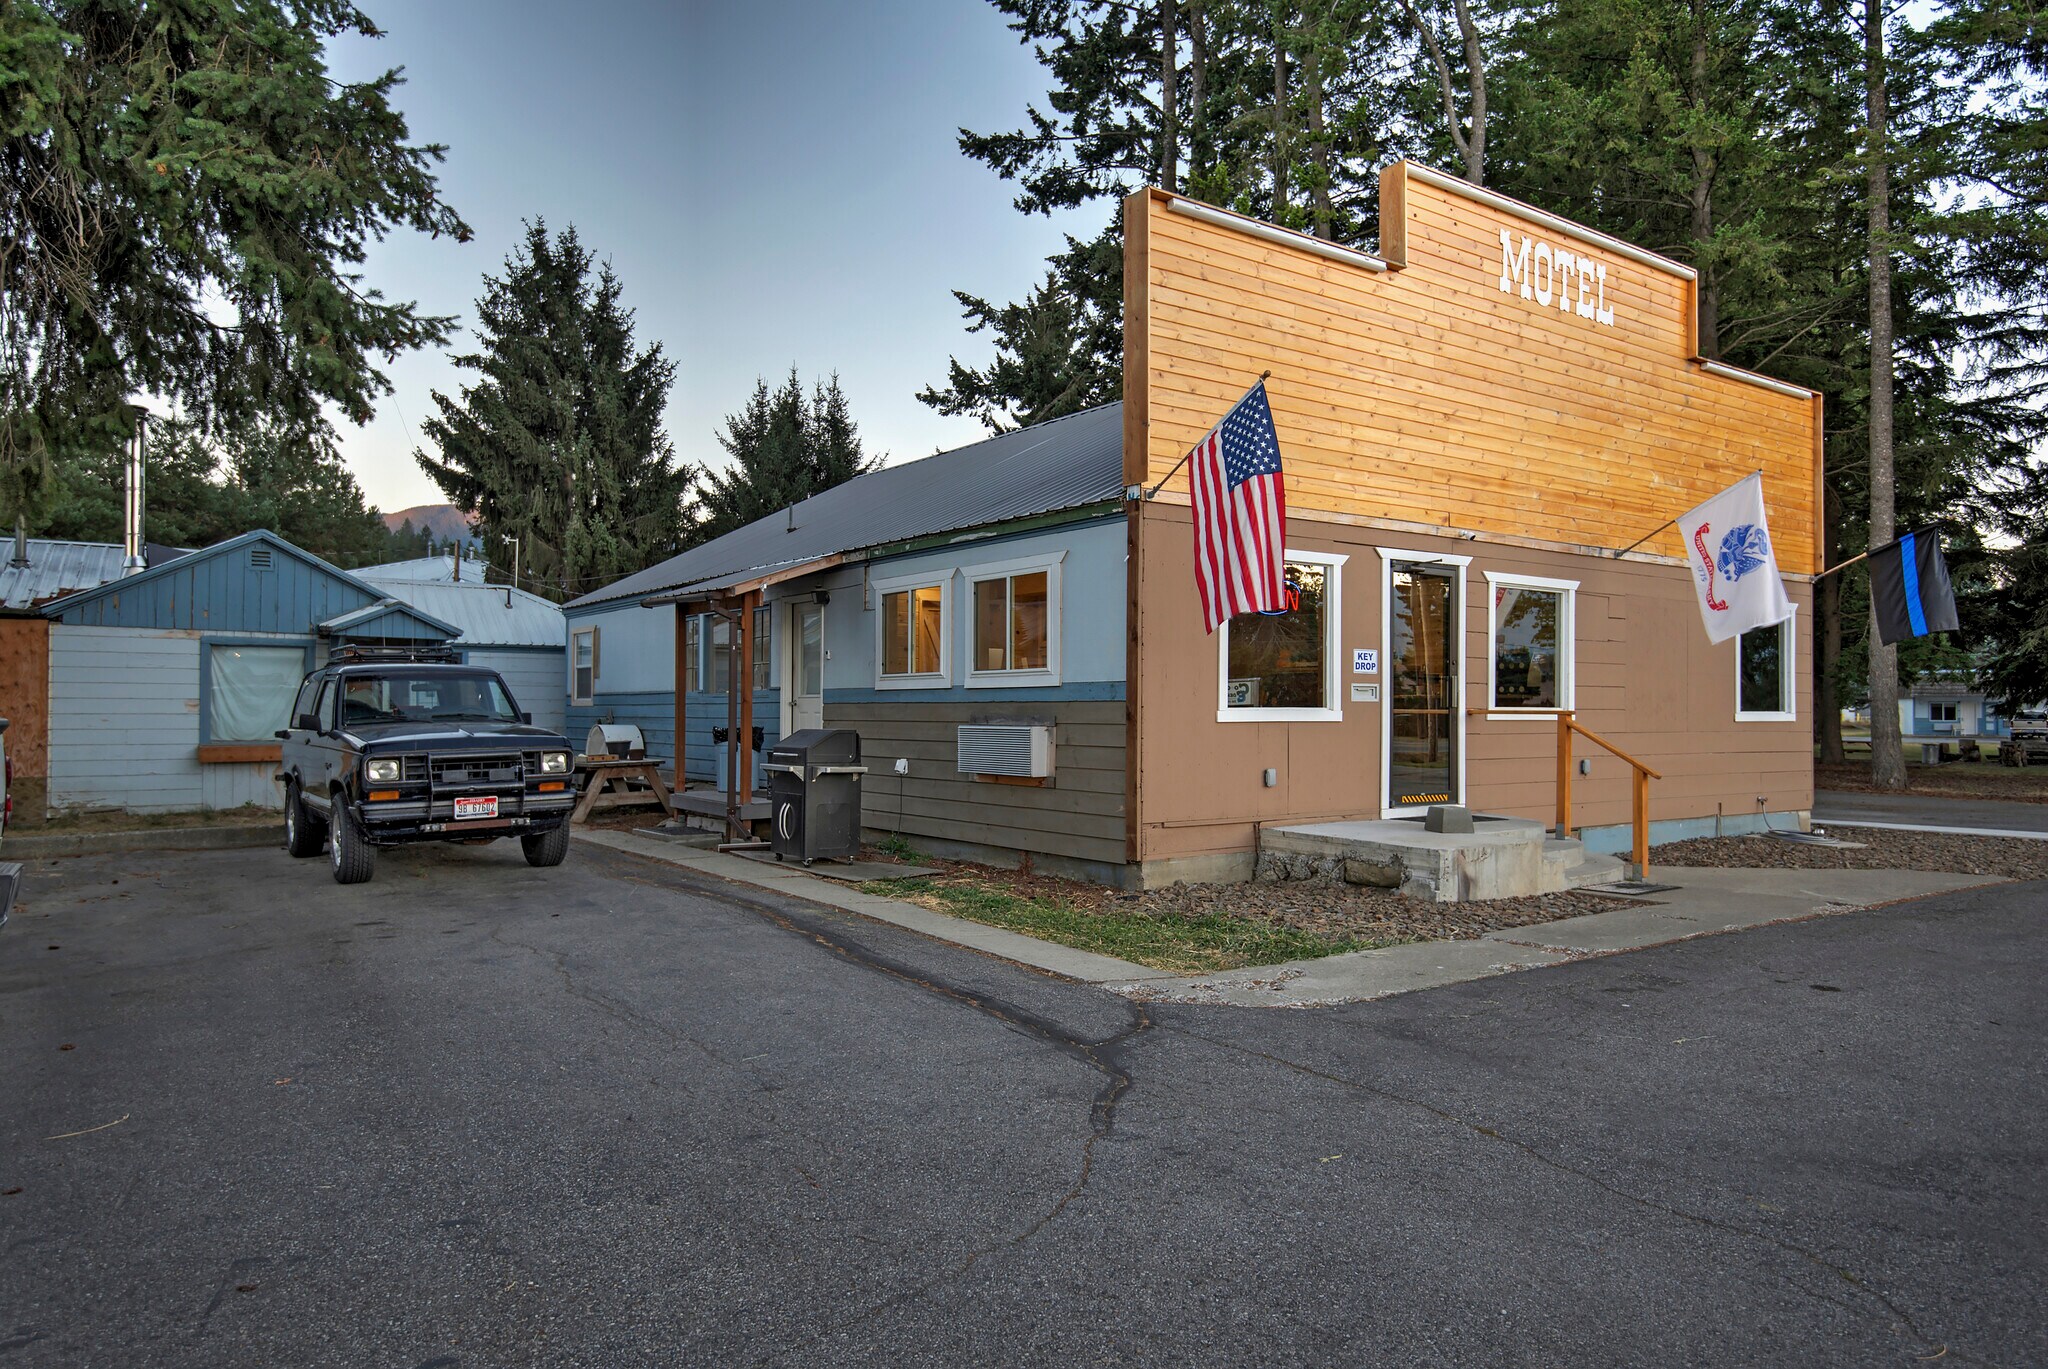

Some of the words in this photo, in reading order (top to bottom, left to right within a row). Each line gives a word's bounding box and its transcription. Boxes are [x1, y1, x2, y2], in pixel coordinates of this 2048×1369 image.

[1499, 228, 1614, 328] MOTEL
[1357, 652, 1374, 661] KEY
[1355, 662, 1376, 671] DROP
[472, 803, 495, 813] 67602
